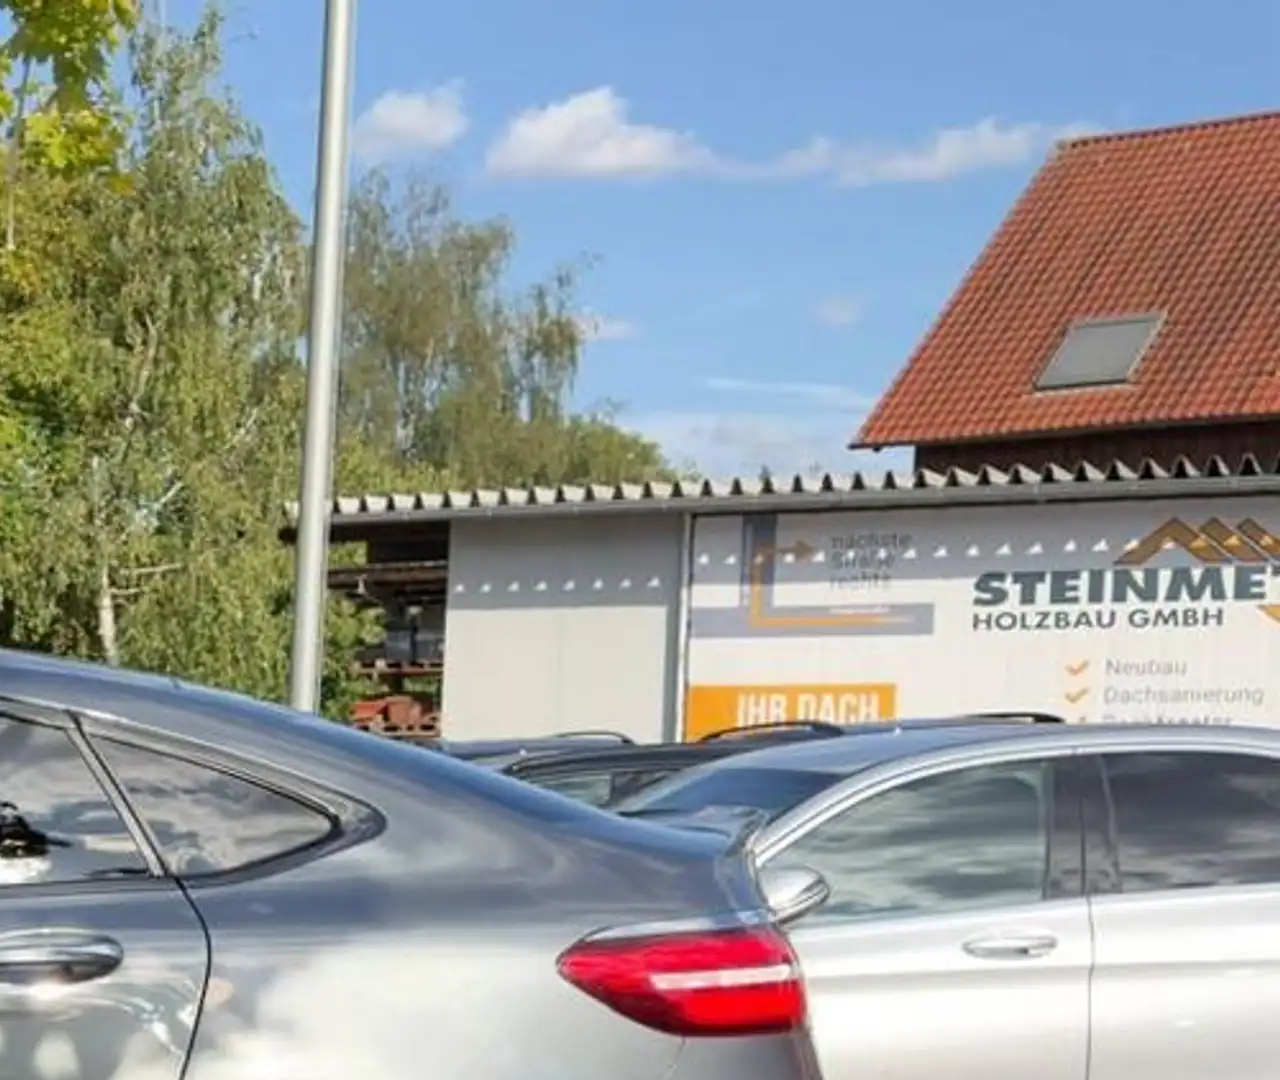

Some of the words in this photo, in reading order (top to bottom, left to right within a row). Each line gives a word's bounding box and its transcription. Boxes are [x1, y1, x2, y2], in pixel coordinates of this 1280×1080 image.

[972, 611, 1116, 631] HOLZBAU
[1128, 608, 1224, 628] GMBH
[1105, 658, 1188, 677] Neubau
[739, 693, 787, 726] IHR
[797, 692, 880, 724] DACH
